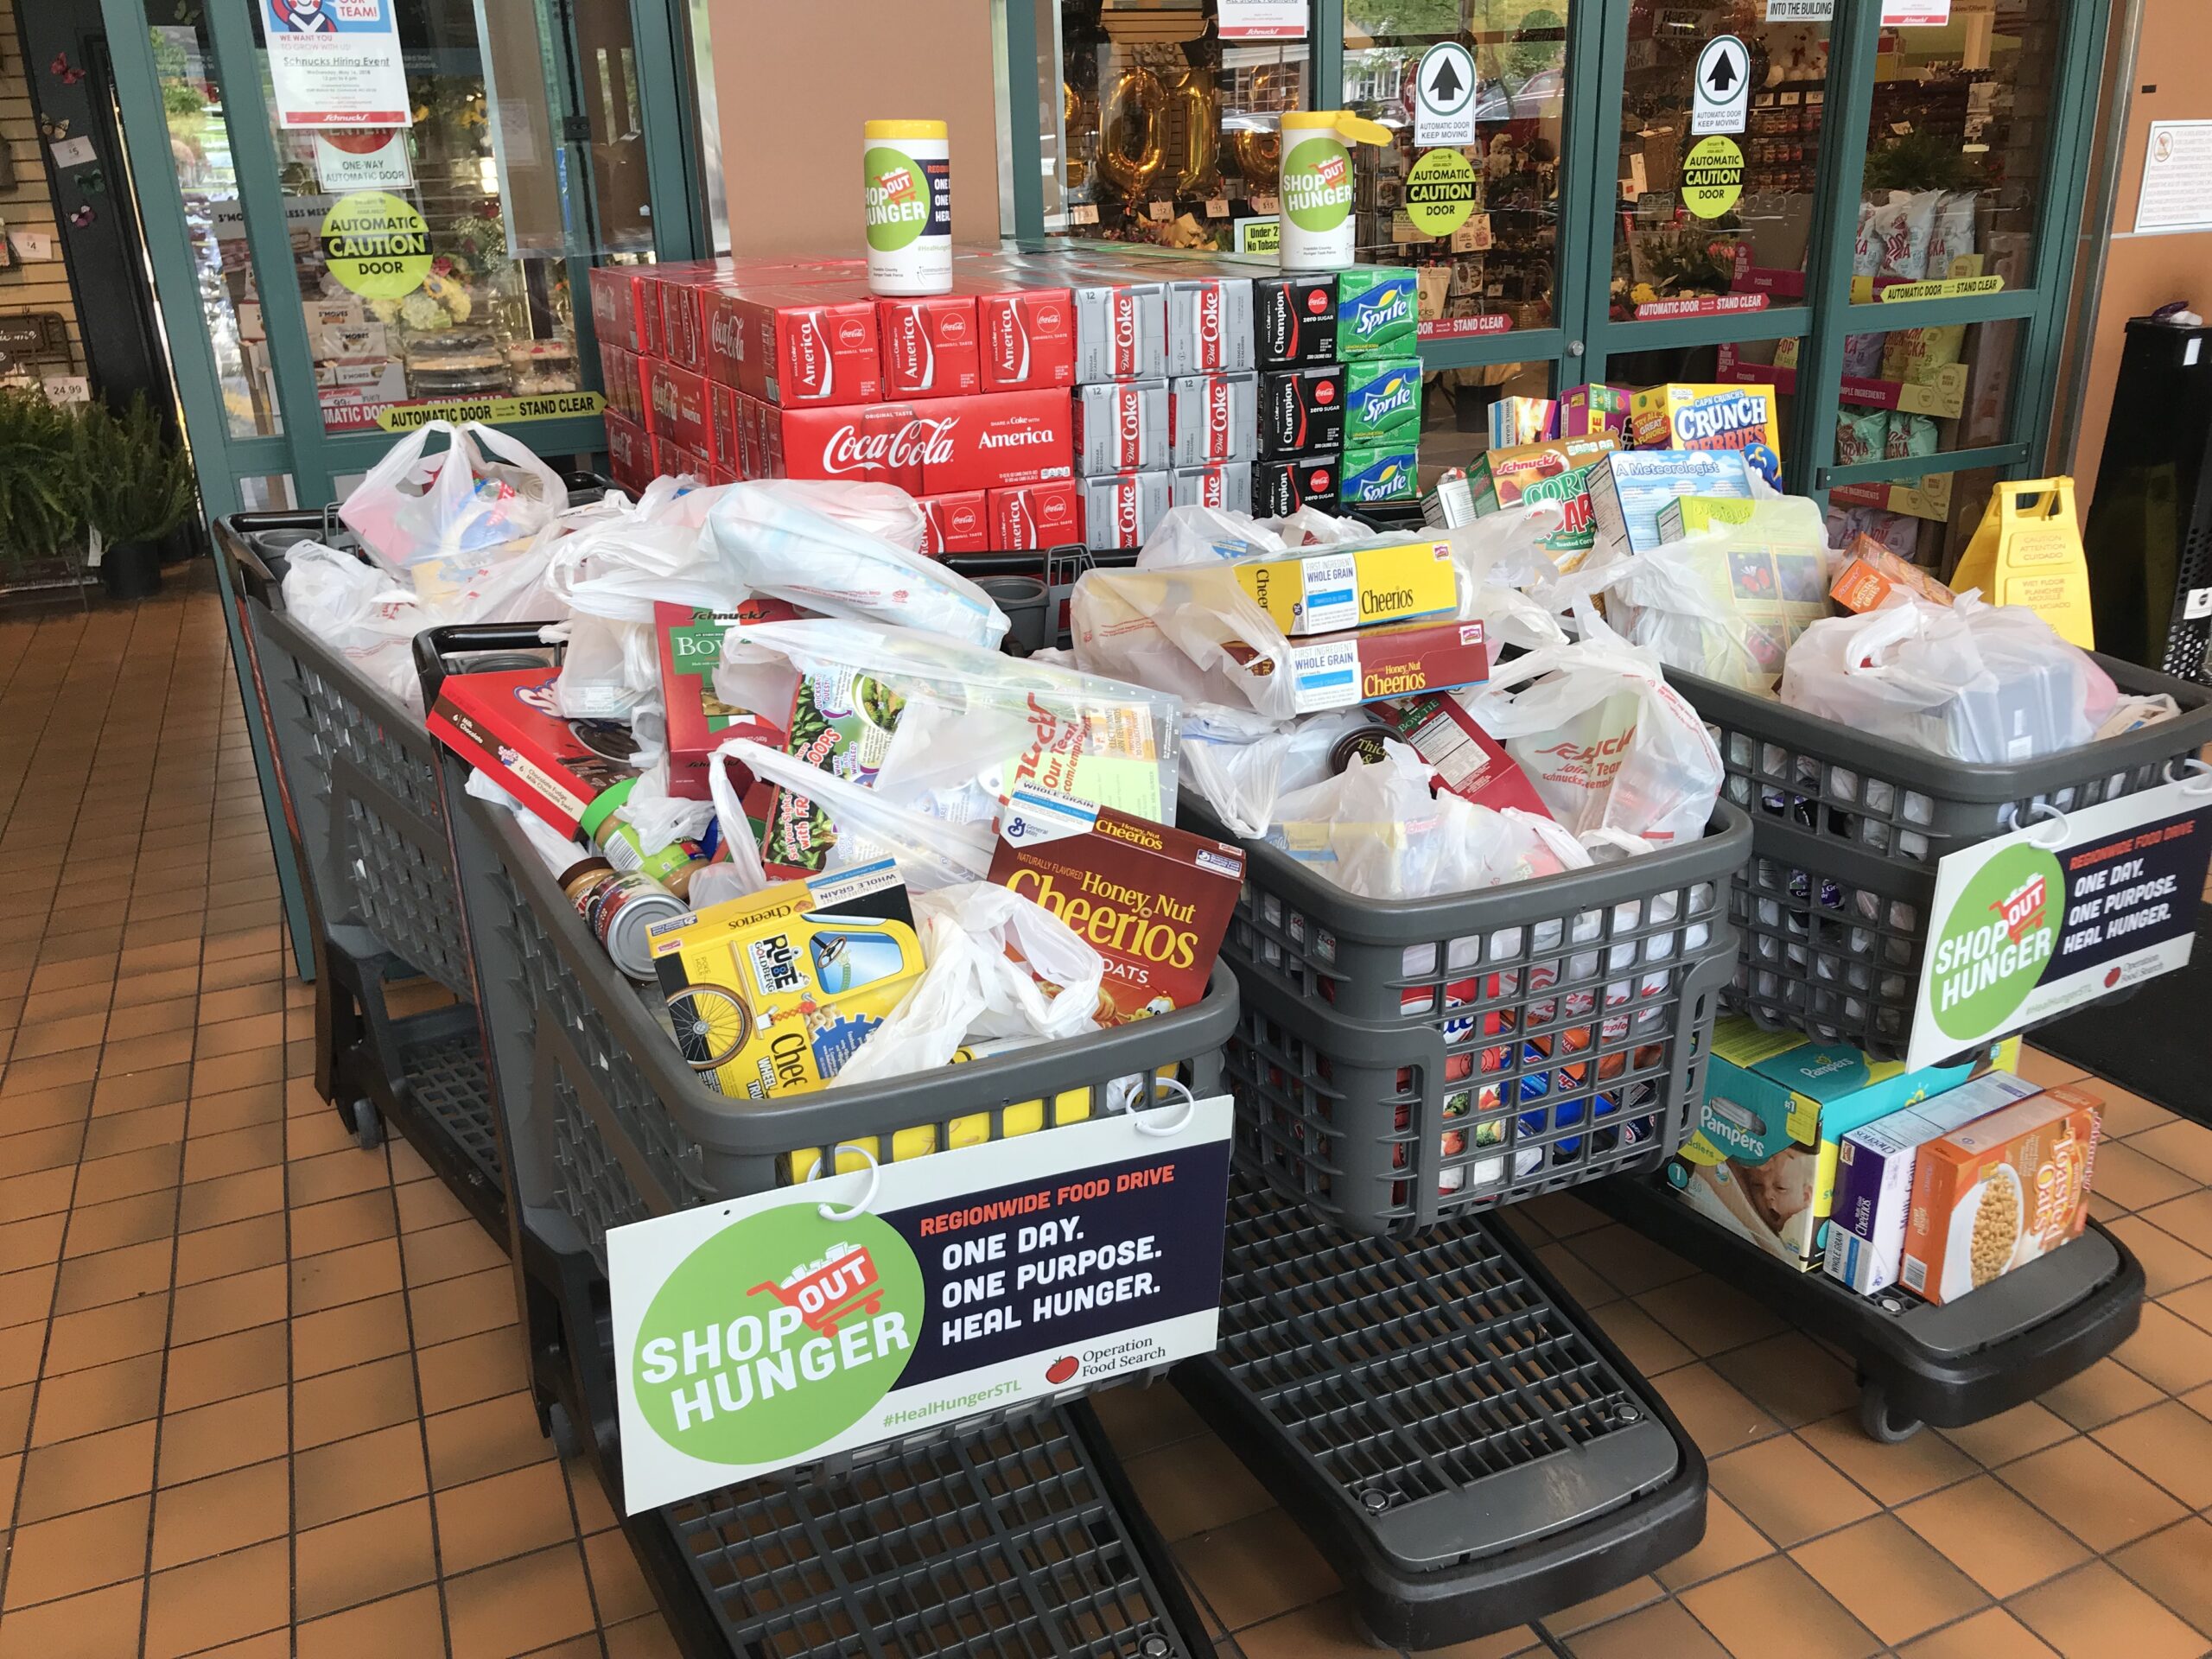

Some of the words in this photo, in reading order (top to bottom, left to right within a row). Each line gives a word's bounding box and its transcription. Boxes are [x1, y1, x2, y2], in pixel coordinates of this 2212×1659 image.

[340, 6, 377, 17] TEAM!
[1770, 3, 1786, 15] INTO
[1788, 3, 1800, 14] THE
[1802, 3, 1831, 14] BUILDING
[283, 57, 330, 67] Schnucks
[334, 57, 360, 67] Hiring
[363, 57, 390, 67] Event
[1697, 111, 1726, 119] AUTOMATIC
[342, 161, 385, 170] ONE-WAY
[1690, 156, 1739, 166] AUTOMATIC
[326, 172, 378, 181] AUTOMATIC
[379, 171, 405, 180] DOOR
[1283, 174, 1325, 192] SHOP
[1414, 169, 1470, 181] AUTOMATIC
[1686, 169, 1740, 185] CAUTION
[1288, 185, 1352, 212] HUNGER
[1410, 184, 1472, 201] CAUTION
[1699, 190, 1724, 199] DOOR
[1427, 205, 1455, 215] DOOR
[330, 216, 418, 232] AUTOMATIC
[328, 235, 426, 257] CAUTION
[359, 262, 404, 275] DOOR
[1887, 288, 1923, 300] AUTOMATIC
[1924, 285, 1942, 297] DOOR
[1956, 283, 1976, 293] STAND
[1978, 279, 1998, 290] CLEAR
[1357, 295, 1408, 334] Sprite
[1639, 302, 1678, 316] AUTOMATIC
[1680, 300, 1699, 313] DOOR
[1717, 297, 1738, 310] STAND
[1740, 296, 1761, 307] CLEAR
[942, 322, 966, 333] Coca-Cola
[1037, 315, 1060, 325] Coca-Cola
[1117, 298, 1133, 346] Coke
[1202, 292, 1219, 343] Coke
[1274, 290, 1287, 354] Champion
[841, 328, 864, 339] Coca-Cola
[1001, 308, 1014, 372] America
[802, 323, 816, 386] America
[904, 315, 918, 378] America
[1206, 343, 1216, 365] Diet
[1121, 348, 1130, 372] Diet
[53, 385, 82, 395] 24.99
[391, 408, 459, 428] AUTOMATIC
[460, 405, 493, 421] DOOR
[519, 398, 556, 416] STAND
[558, 397, 596, 413] CLEAR
[1211, 385, 1228, 432] Coke
[1283, 383, 1294, 444] Champion
[1363, 387, 1411, 423] Sprite
[1122, 392, 1139, 441] Coke
[1677, 397, 1768, 442] CRUNCH
[823, 416, 961, 474] Coca-Cola
[978, 427, 1055, 449] America
[1215, 433, 1224, 454] Diet
[1126, 442, 1135, 464] Diet
[1497, 450, 1559, 474] Schnucks
[1617, 463, 1627, 475] A
[1630, 461, 1720, 477] Meteorologist
[1556, 539, 1579, 548] Toasted
[1580, 537, 1593, 546] Corn
[2020, 543, 2066, 552] ATTENTION
[1306, 562, 1325, 571] FIRST
[1325, 558, 1352, 568] INGREDIENT
[1307, 570, 1332, 583] WHOLE
[1332, 568, 1353, 580] GRAIN
[1362, 586, 1414, 615] Cheerios
[687, 611, 770, 621] Schnucks
[1295, 648, 1314, 658] FIRST
[1316, 644, 1352, 655] INGREDIENT
[1295, 657, 1326, 671] WHOLE
[1327, 653, 1353, 665] GRAIN
[1385, 664, 1407, 675] Honey
[1408, 661, 1421, 671] Nut
[1364, 671, 1426, 697] Cheerios
[460, 723, 483, 744] Chocolate
[1026, 829, 1039, 837] Mills
[1096, 819, 1163, 850] Cheerios
[1122, 822, 1147, 836] Honey
[1147, 831, 1160, 840] Nut
[1017, 851, 1052, 870] NATURALLY
[1052, 863, 1084, 880] FLAVORED
[857, 872, 896, 889] WHOLE
[2075, 870, 2108, 897] ONE
[2109, 858, 2145, 886] DAY.
[820, 884, 855, 900] GRAIN
[1081, 871, 1151, 912] Honey
[1154, 894, 1197, 924] Nut
[2069, 899, 2103, 926] ONE
[2104, 874, 2177, 913] PURPOSE.
[2008, 884, 2044, 926] OUT
[728, 904, 791, 931] Cheerios
[2063, 925, 2103, 955] HEAL
[2106, 903, 2171, 939] HUNGER.
[1936, 919, 2010, 975] SHOP
[696, 958, 705, 976] HOLE
[702, 957, 711, 974] POKE
[1941, 927, 2052, 1013] HUNGER
[758, 1057, 777, 1090] WHEEL
[1800, 1058, 1854, 1079] Pampers
[1784, 1100, 1796, 1113] #1
[1700, 1104, 1765, 1158] Pampers
[1674, 1166, 1681, 1181] 1
[921, 1192, 1051, 1237] REGIONWIDE
[1057, 1179, 1110, 1206] FOOD
[1116, 1164, 1175, 1193] DRIVE
[942, 1233, 1007, 1271] ONE
[1018, 1215, 1084, 1254] DAY.
[1835, 1230, 1844, 1252] GRAIN
[942, 1270, 1006, 1308] ONE
[1017, 1236, 1162, 1290] PURPOSE.
[1831, 1249, 1842, 1274] WHOLE
[798, 1255, 866, 1313] OUT
[942, 1306, 1022, 1346] HEAL
[1033, 1273, 1160, 1323] HUNGER.
[641, 1306, 803, 1383] SHOP
[1082, 1338, 1153, 1364] Operation
[671, 1312, 911, 1432] HUNGER
[1082, 1360, 1116, 1377] Food
[1119, 1347, 1166, 1368] Search
[883, 1381, 1022, 1427] #HealHungerSTL
